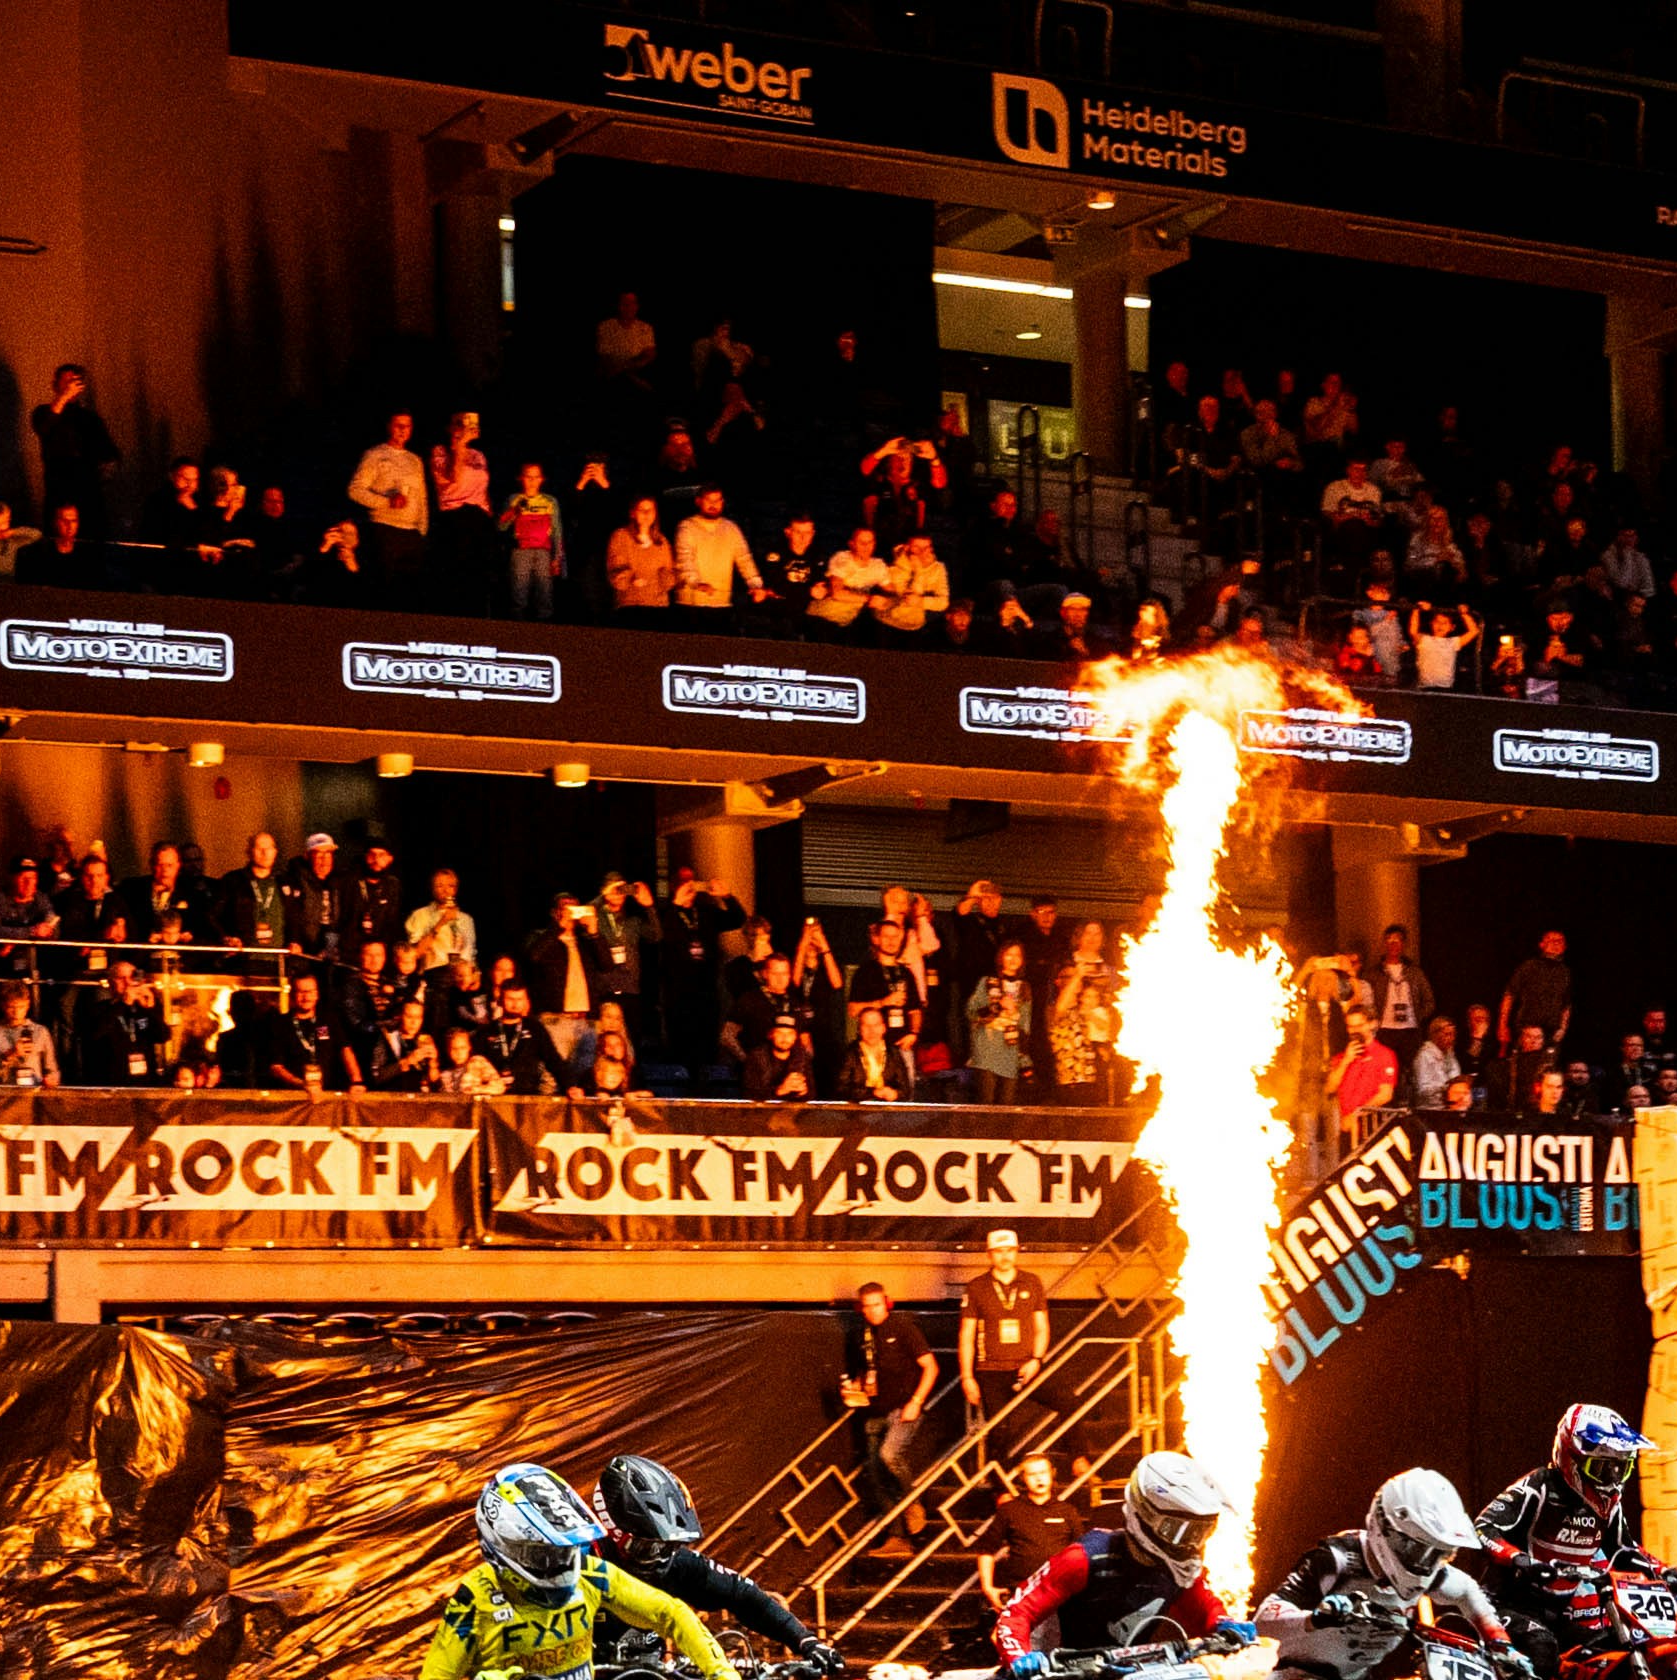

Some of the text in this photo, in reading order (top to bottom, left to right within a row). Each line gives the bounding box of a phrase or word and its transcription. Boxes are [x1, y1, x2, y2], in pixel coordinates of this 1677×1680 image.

[646, 40, 812, 101] weber
[1083, 98, 1248, 154] Heidelberg
[1083, 135, 1228, 178] Materials
[11, 632, 224, 669] MOTOEXTREME
[355, 654, 552, 691] MOTOEXTREME
[671, 676, 858, 714] MOTOEXTREME
[970, 698, 1112, 730] MOTOEXTR
[1247, 719, 1405, 751] MOTOEXTREME
[1502, 738, 1652, 772] MOTOEXTREME
[4, 1138, 109, 1198] FM
[135, 1138, 445, 1202] ROCK FM
[527, 1146, 820, 1204] ROCK FM
[846, 1149, 1115, 1205] ROCK FM
[1418, 1131, 1594, 1184] AUGUSTI
[502, 1602, 592, 1653] FXR
[1627, 1592, 1676, 1621] 248
